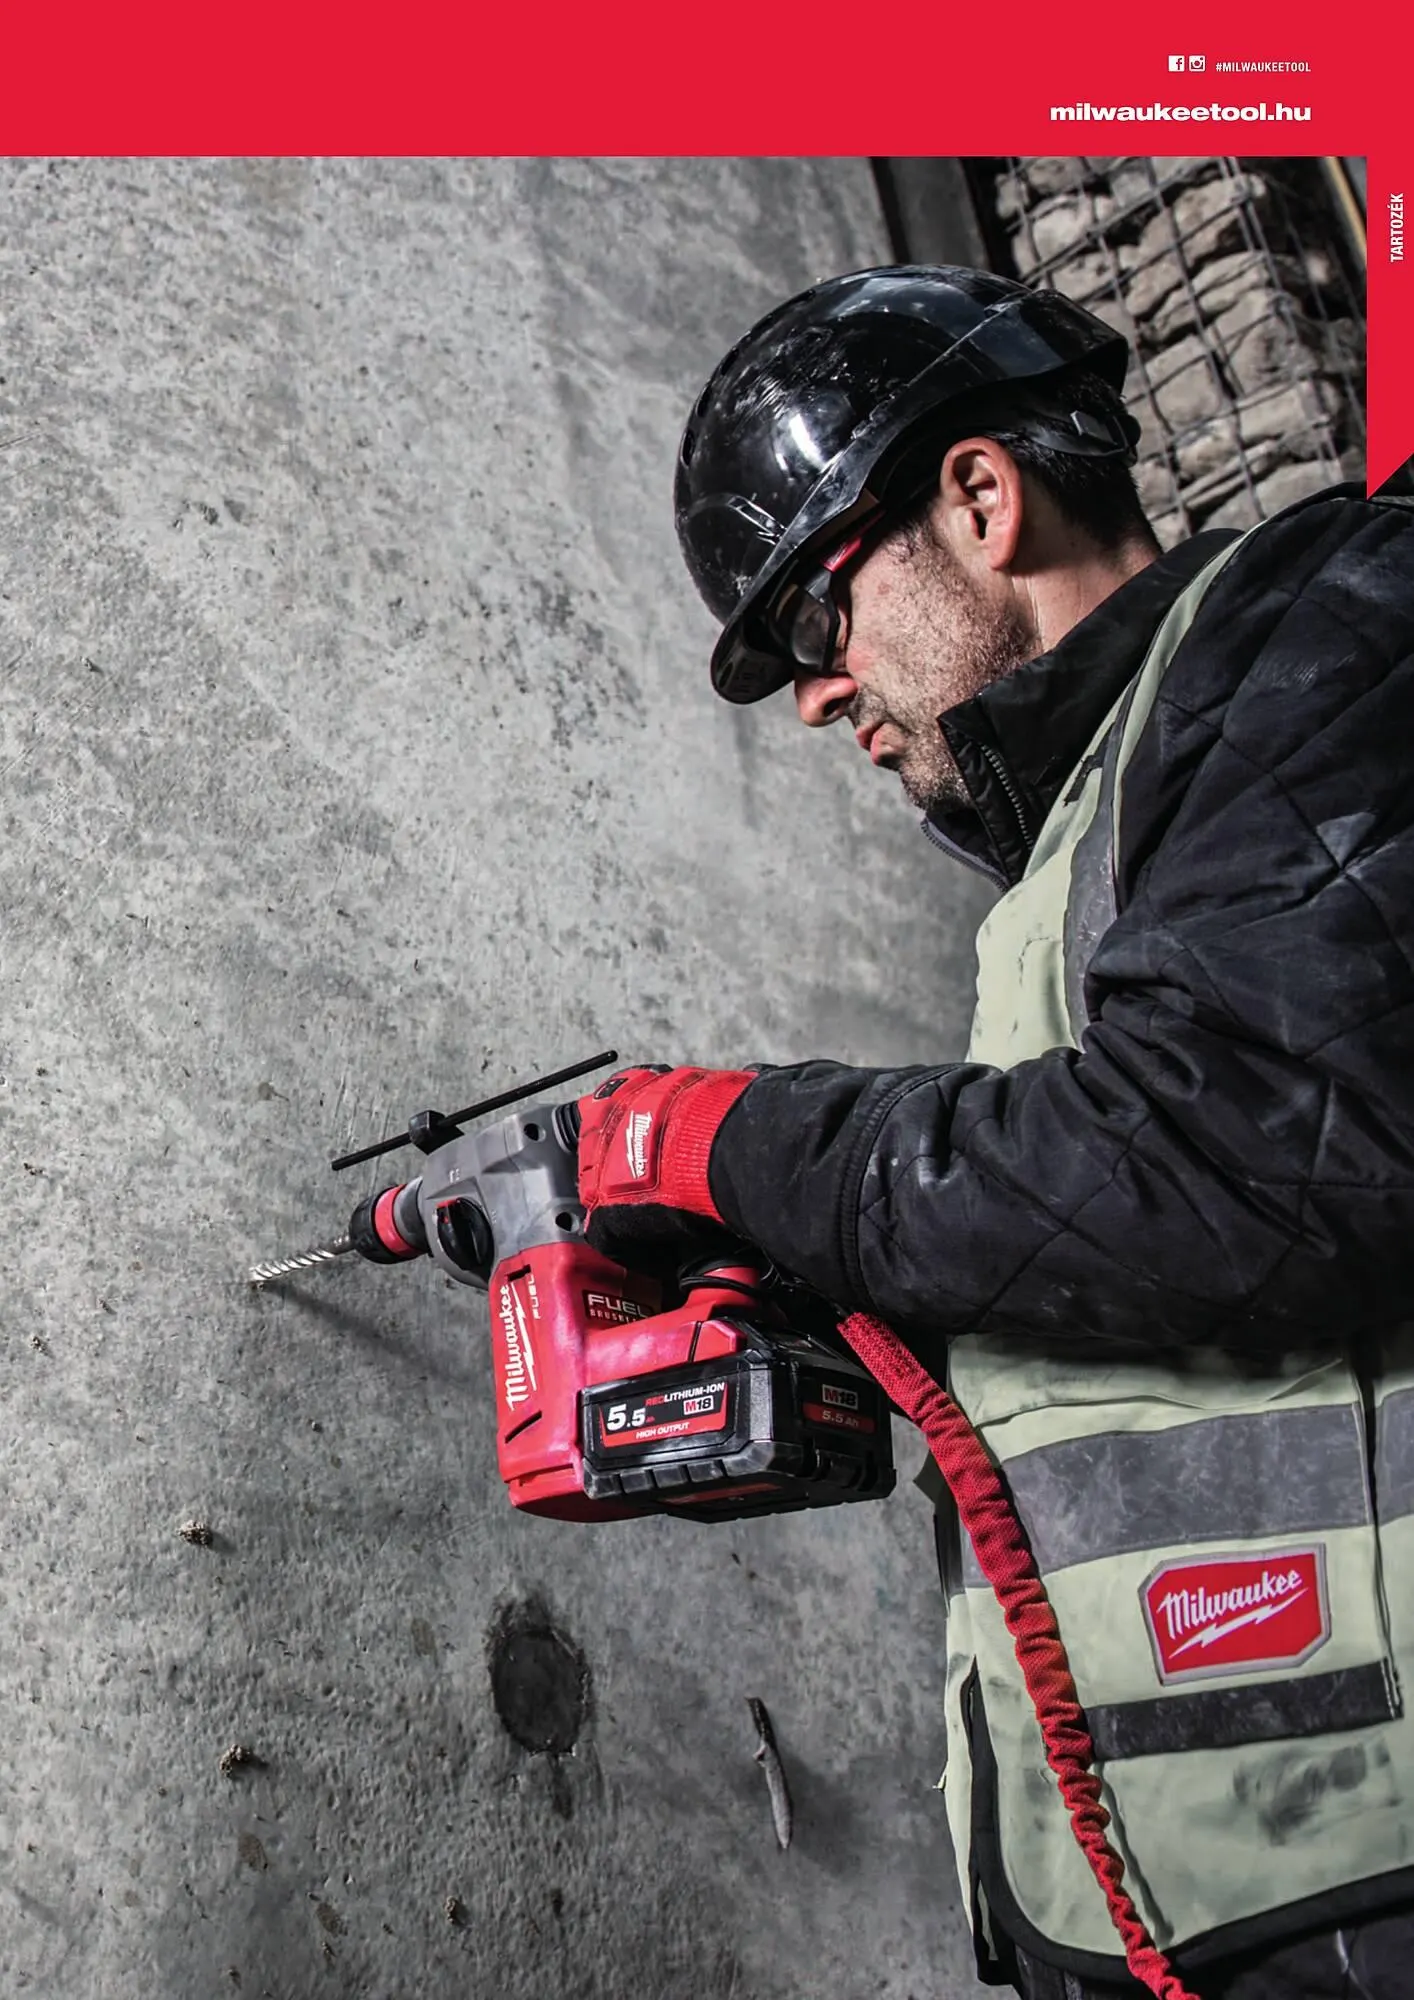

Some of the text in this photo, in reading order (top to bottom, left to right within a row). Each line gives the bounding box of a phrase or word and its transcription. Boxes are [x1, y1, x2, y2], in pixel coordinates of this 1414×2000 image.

[588, 1294, 648, 1318] FUEL
[499, 1284, 529, 1411] Milwaukee
[685, 1399, 712, 1413] M18
[825, 1389, 857, 1406] M18
[822, 1409, 844, 1423] 5.5
[635, 1422, 690, 1439] HIGH OUTPUT
[1156, 1569, 1303, 1639] Milwaukee
